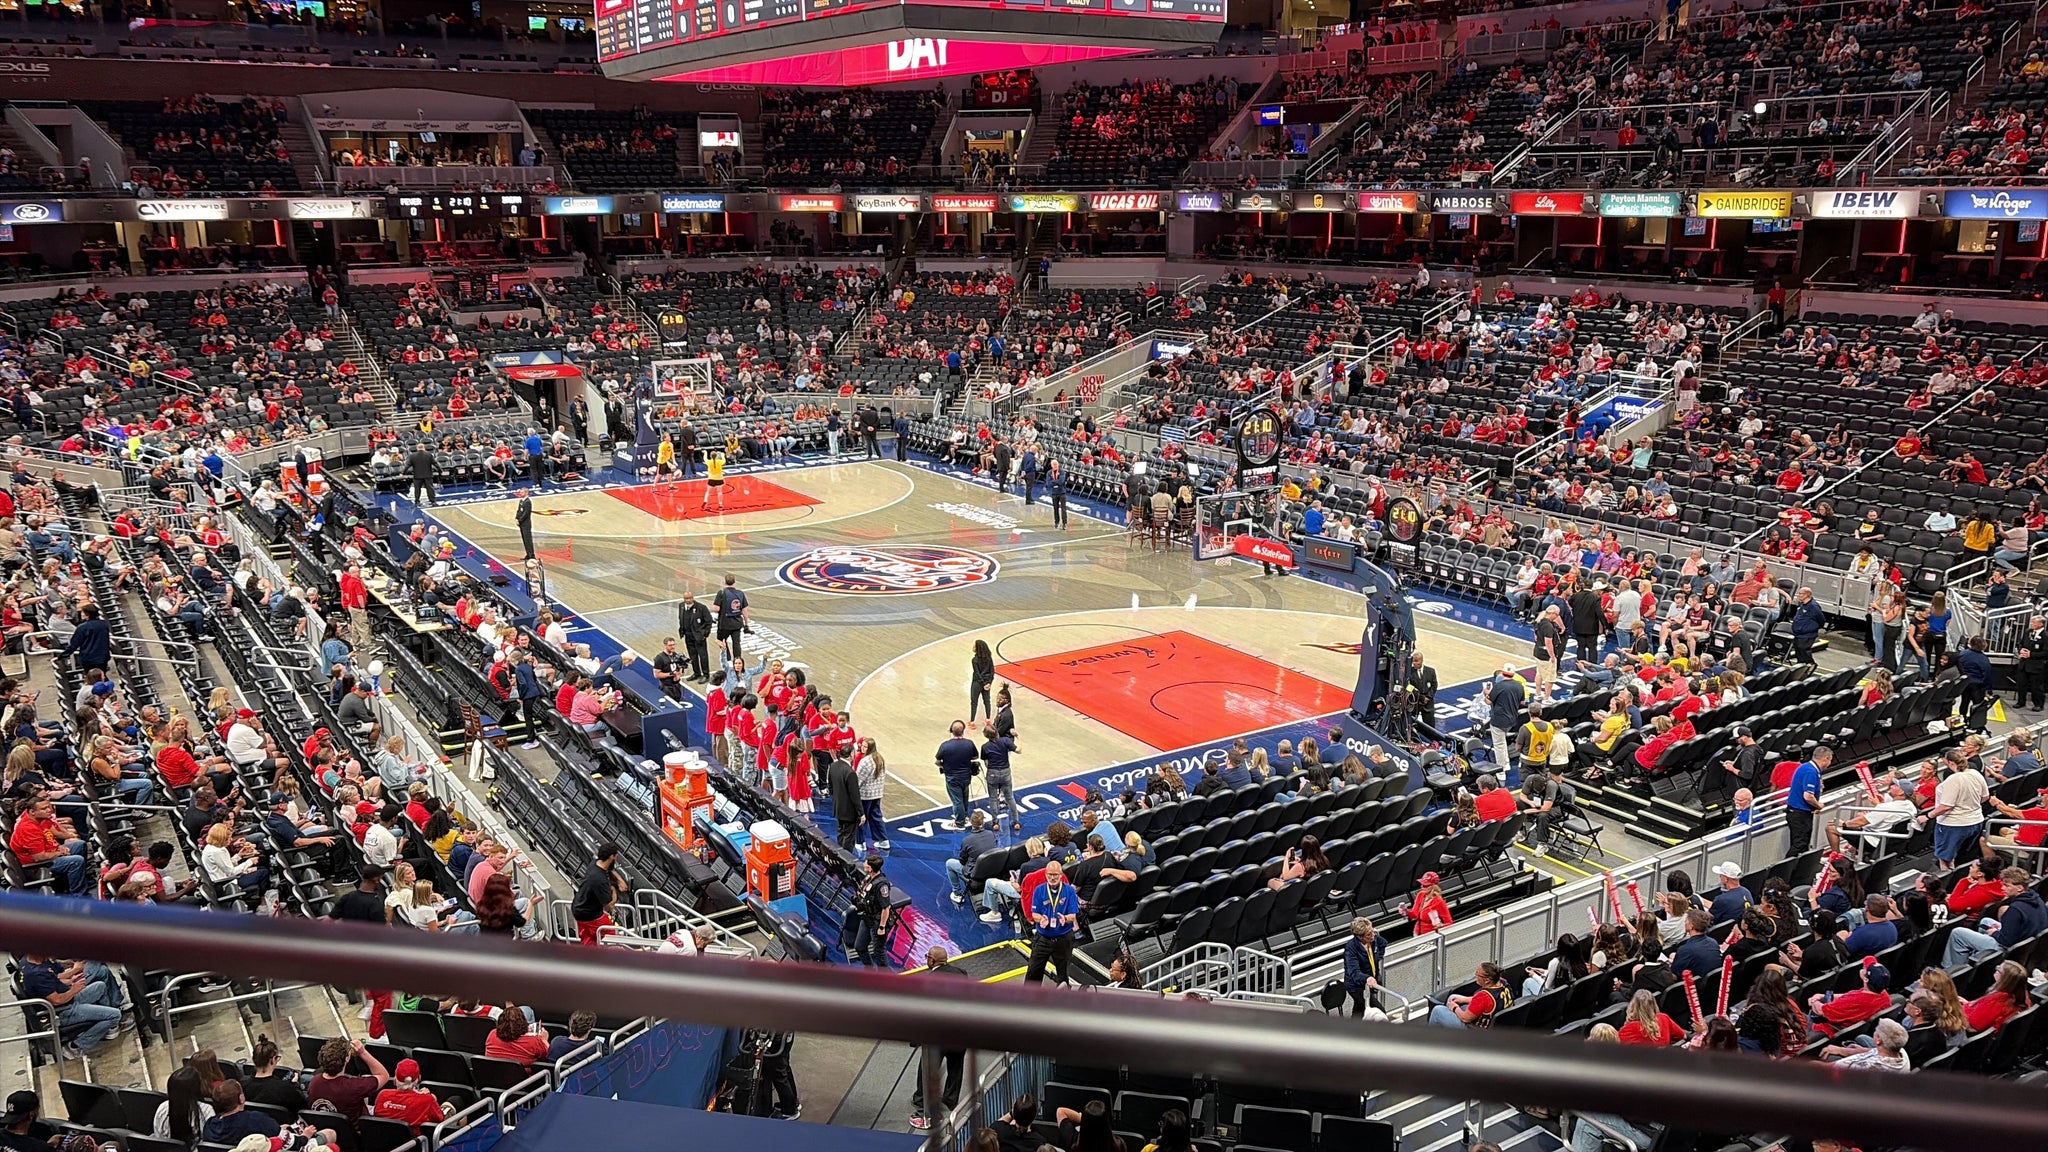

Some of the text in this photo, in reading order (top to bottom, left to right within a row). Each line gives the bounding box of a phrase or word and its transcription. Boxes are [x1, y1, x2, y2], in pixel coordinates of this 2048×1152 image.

[888, 38, 948, 71] DAY
[991, 91, 1008, 103] DJ
[663, 198, 723, 210] ticketmaster
[857, 199, 897, 210] KeyBank
[934, 199, 961, 208] STEAK
[967, 199, 995, 208] SHAKE
[1091, 194, 1159, 210] LUCAS OIL
[1187, 196, 1213, 209] xfinity
[1382, 196, 1403, 209] mhs
[1433, 197, 1493, 209] AMBROSE
[1534, 196, 1557, 212] Lilly
[1610, 193, 1670, 204] Peyton Manning
[1715, 197, 1787, 212] GAINBRIDGE
[1832, 191, 1898, 209] IBEW
[1988, 191, 2032, 217] Kroger
[1082, 375, 1105, 385] NOW
[1243, 418, 1273, 436] 21:10
[1392, 508, 1417, 522] 21:10
[1059, 650, 1138, 666] WNBA
[1345, 735, 1409, 773] coinse
[1098, 747, 1229, 791] Mihelob
[897, 793, 1062, 838] URA
[754, 840, 761, 853] G
[751, 870, 758, 884] G
[1931, 903, 1949, 924] 22
[1500, 987, 1513, 1009] 22
